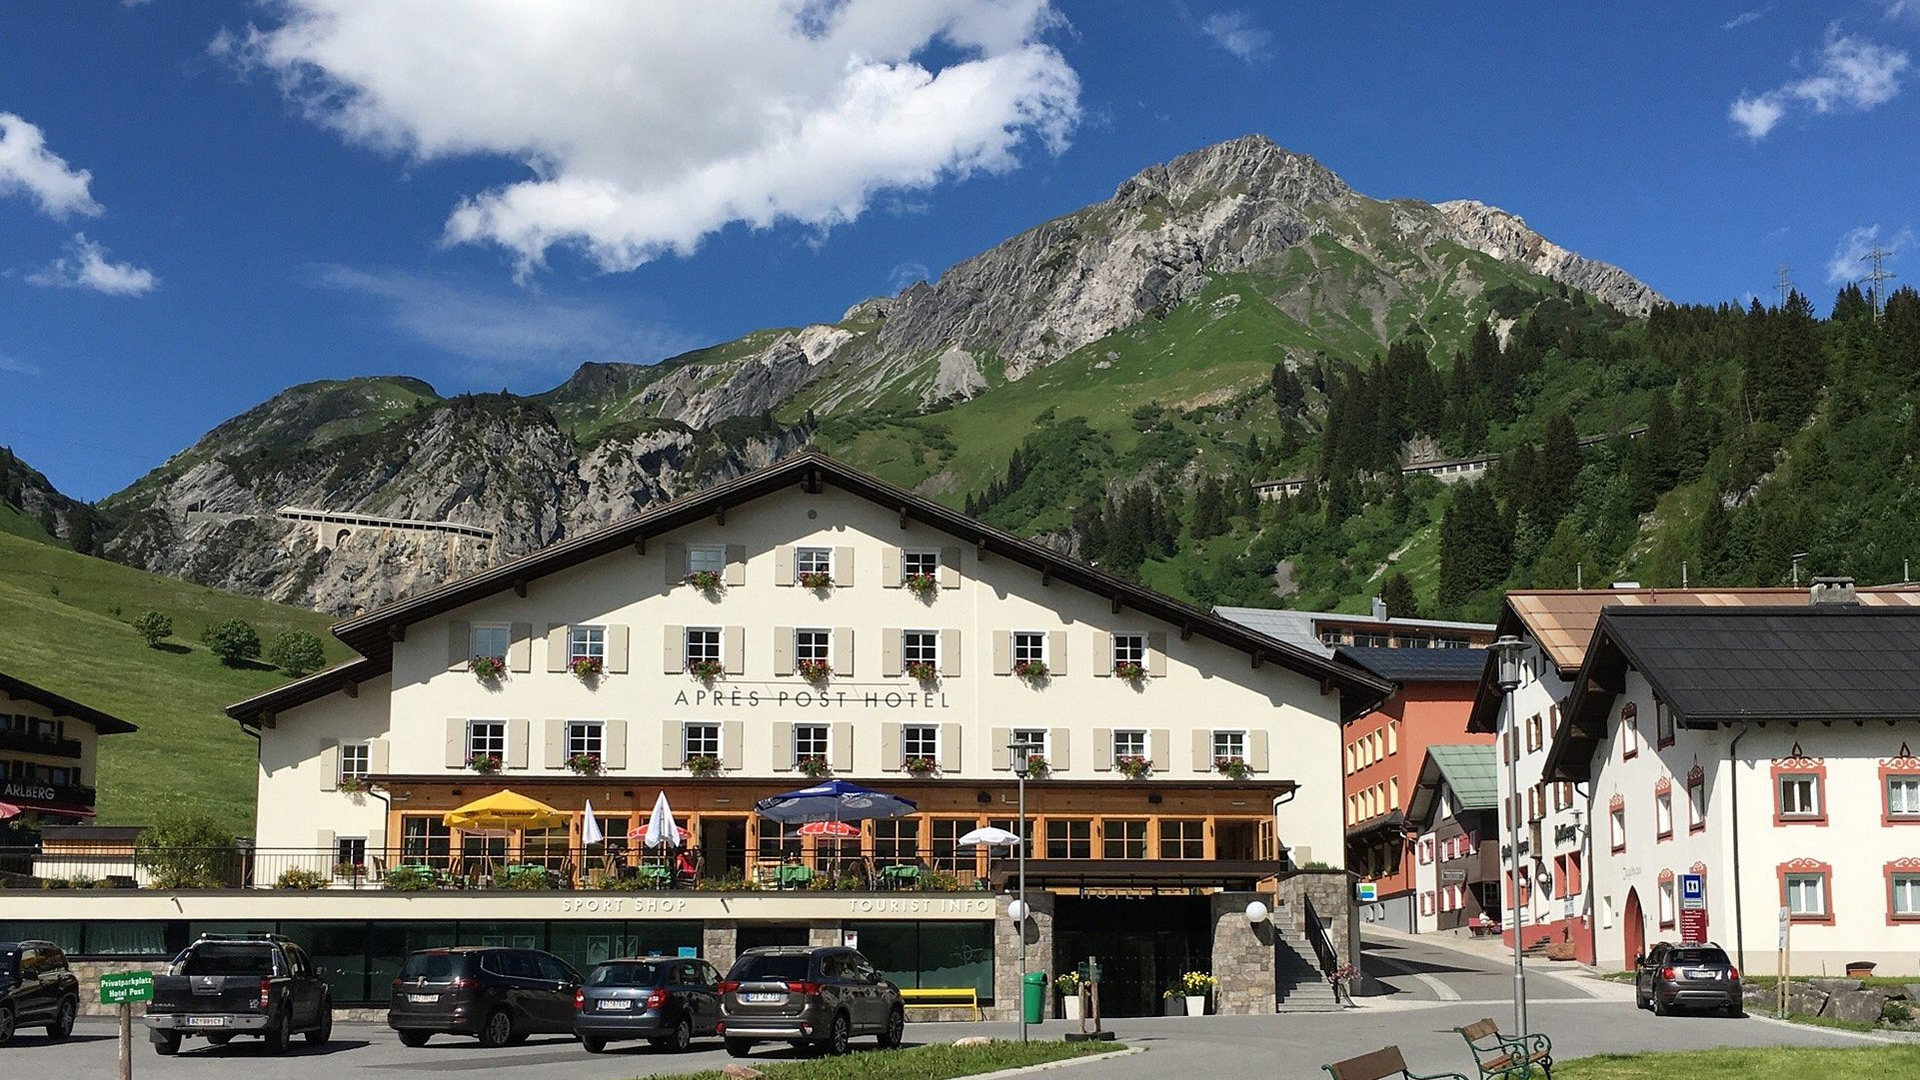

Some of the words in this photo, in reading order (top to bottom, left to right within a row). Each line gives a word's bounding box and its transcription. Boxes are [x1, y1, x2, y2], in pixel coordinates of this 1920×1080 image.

[674, 686, 759, 707] APRÈS
[779, 691, 847, 707] POST
[865, 691, 949, 708] HOTEL
[4, 783, 55, 800] ARLBERG
[562, 899, 623, 912] SPORT
[635, 899, 686, 912] SHOP
[849, 899, 930, 912] TOURIST
[942, 899, 989, 913] INFO
[100, 976, 152, 988] Privatparkplatz
[109, 988, 127, 998] Hotel
[129, 987, 145, 996] Post
